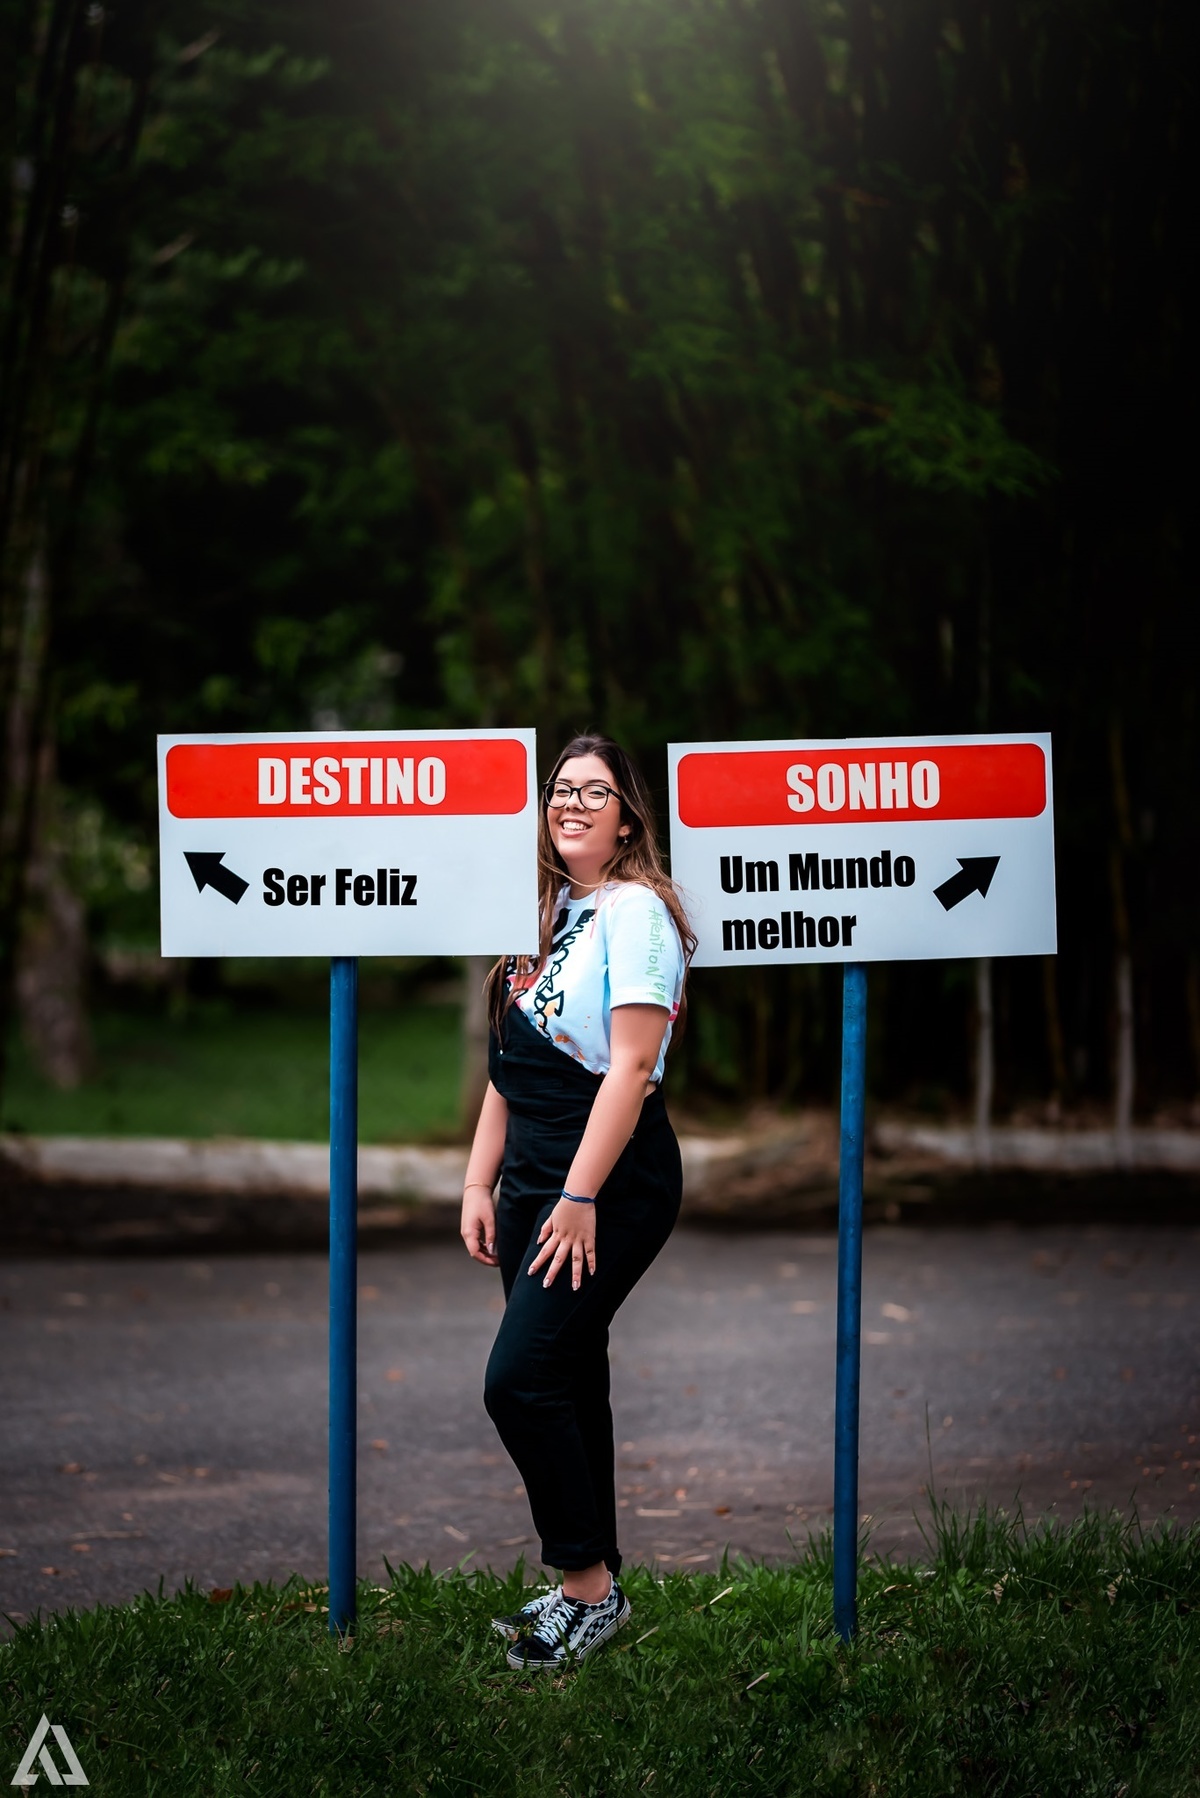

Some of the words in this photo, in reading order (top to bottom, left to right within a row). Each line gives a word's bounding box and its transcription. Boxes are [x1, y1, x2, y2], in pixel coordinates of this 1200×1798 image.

[259, 757, 445, 805] DESTINO
[787, 761, 939, 812] SONHO
[263, 868, 326, 906] Ser
[336, 869, 417, 906] Feliz
[720, 856, 779, 893] Um
[789, 850, 915, 890] Mundo
[723, 911, 856, 951] melhor
